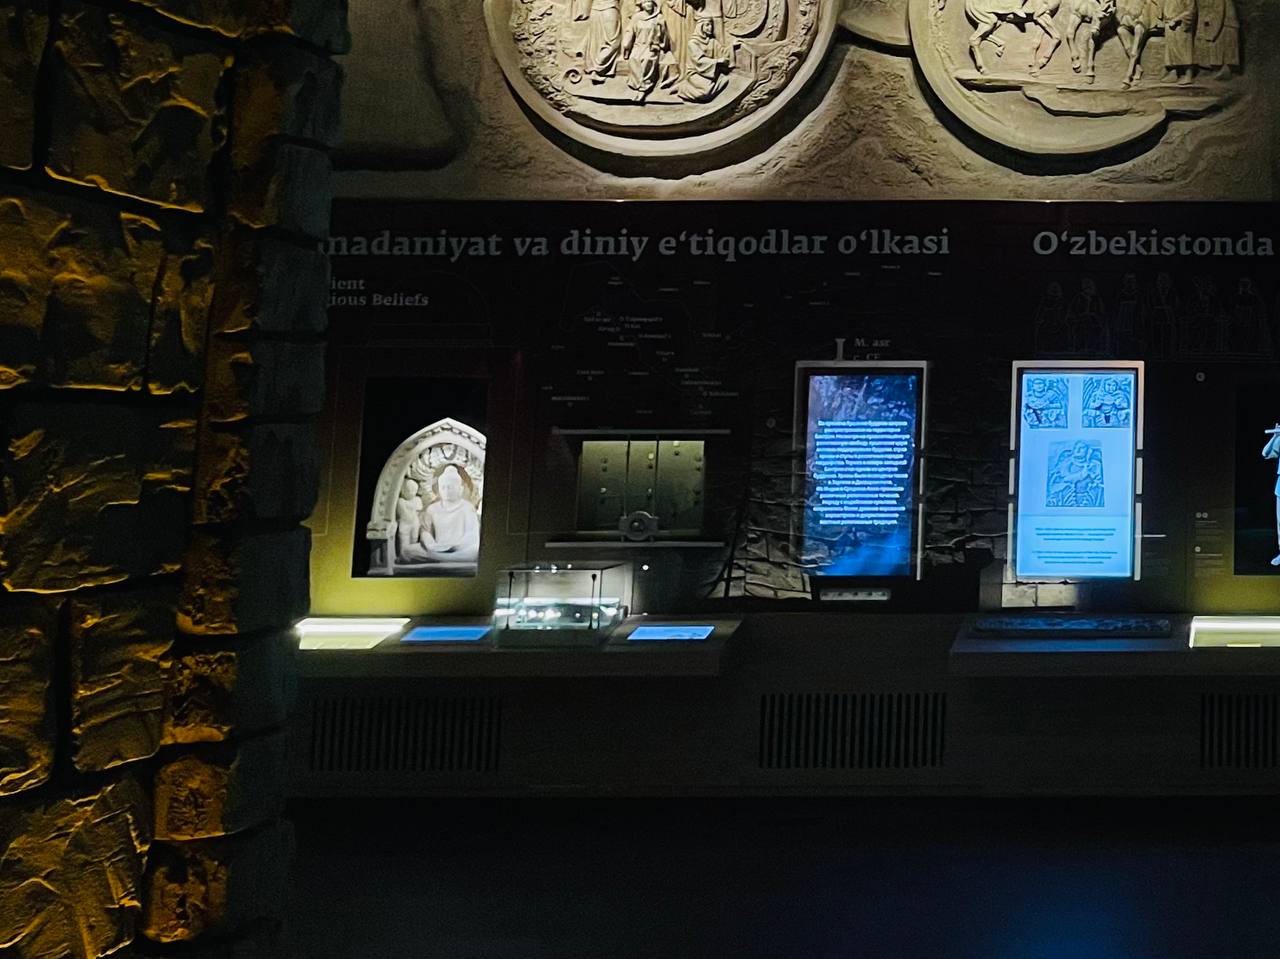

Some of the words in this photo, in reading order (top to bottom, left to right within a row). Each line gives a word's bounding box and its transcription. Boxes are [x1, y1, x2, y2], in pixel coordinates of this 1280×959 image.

[512, 236, 550, 256] va
[559, 228, 649, 262] diniy
[329, 276, 366, 290] ient
[329, 293, 367, 307] ious
[372, 292, 430, 307] Beliefs
